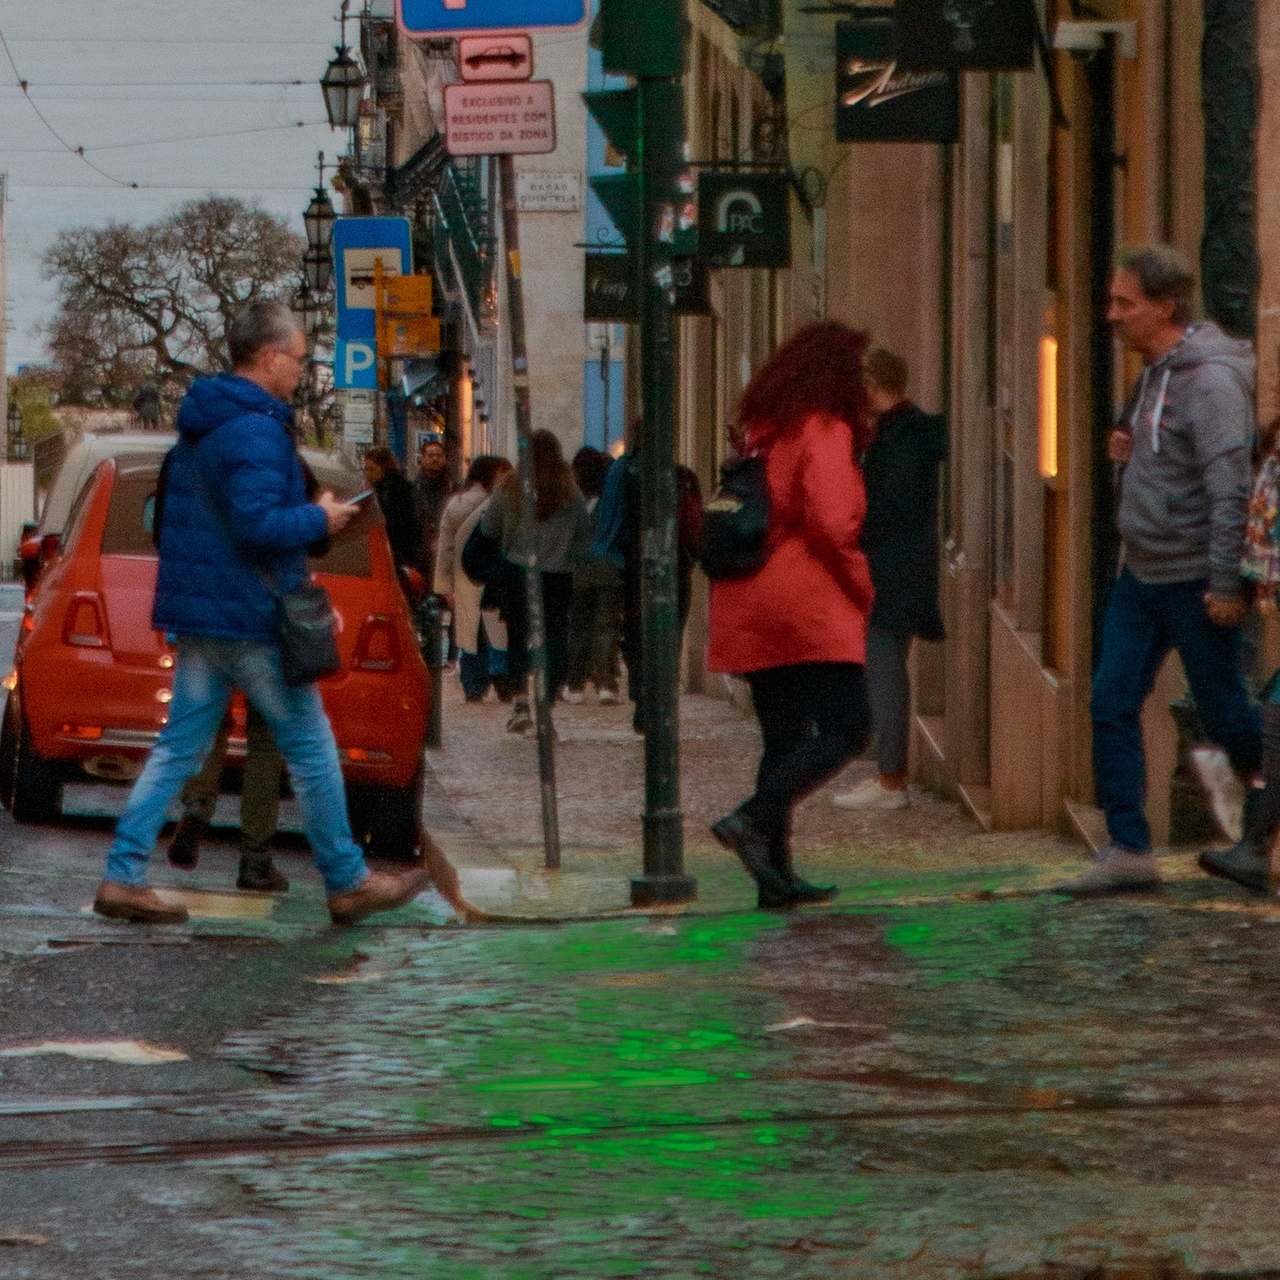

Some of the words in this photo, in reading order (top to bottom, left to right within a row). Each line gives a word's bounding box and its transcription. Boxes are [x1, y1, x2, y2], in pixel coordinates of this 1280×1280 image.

[462, 96, 522, 107] EXCLUSIVO
[452, 113, 518, 124] RESIDENTES
[523, 112, 547, 122] COM
[500, 131, 514, 140] DA
[520, 130, 548, 139] ZONA
[345, 343, 375, 385] P
